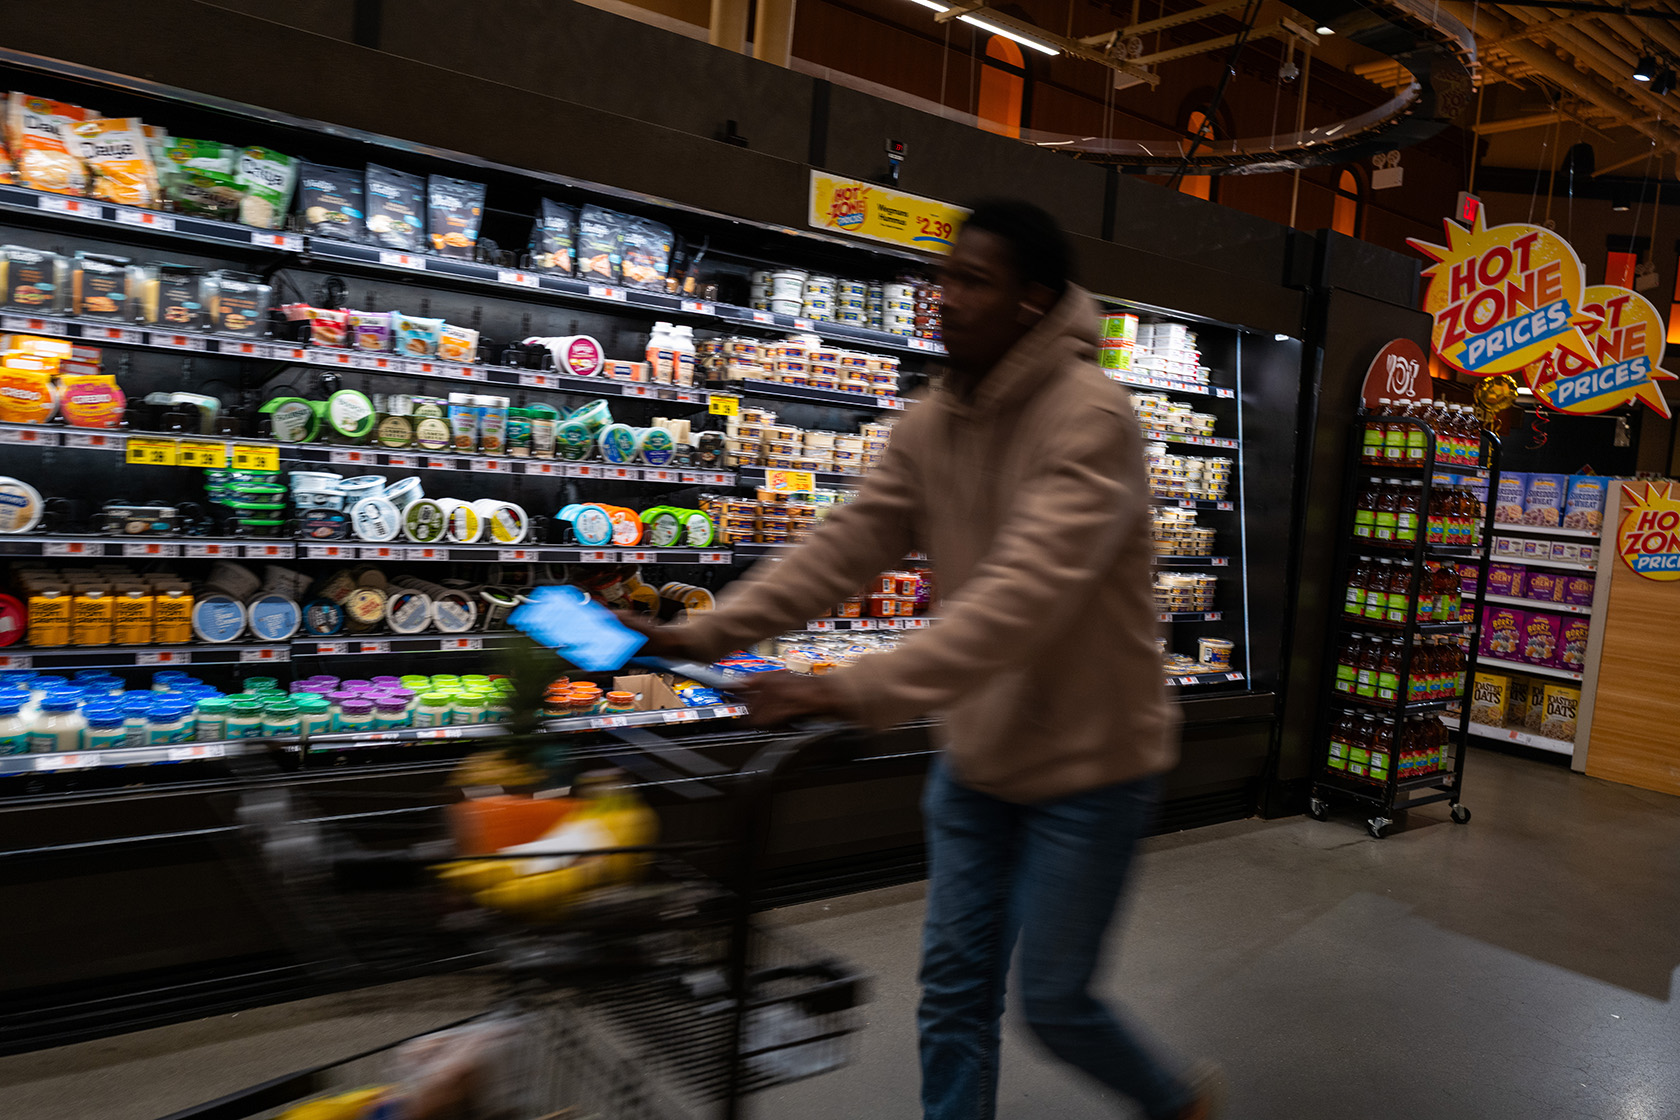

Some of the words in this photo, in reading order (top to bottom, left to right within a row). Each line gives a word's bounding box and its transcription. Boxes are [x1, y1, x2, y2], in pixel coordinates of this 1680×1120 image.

[834, 187, 861, 202] HOT
[1451, 231, 1539, 304] HOT
[1436, 259, 1563, 355] ZONE
[1468, 300, 1568, 365] PRICES
[1558, 356, 1647, 404] PRICES
[1636, 510, 1680, 532] HO
[1621, 531, 1680, 556] ZON
[1637, 555, 1680, 570] PRIC
[1474, 681, 1503, 693] TOASTED
[1474, 689, 1501, 704] OATS
[1547, 694, 1578, 708] TOASTED
[1547, 703, 1577, 719] OATS
